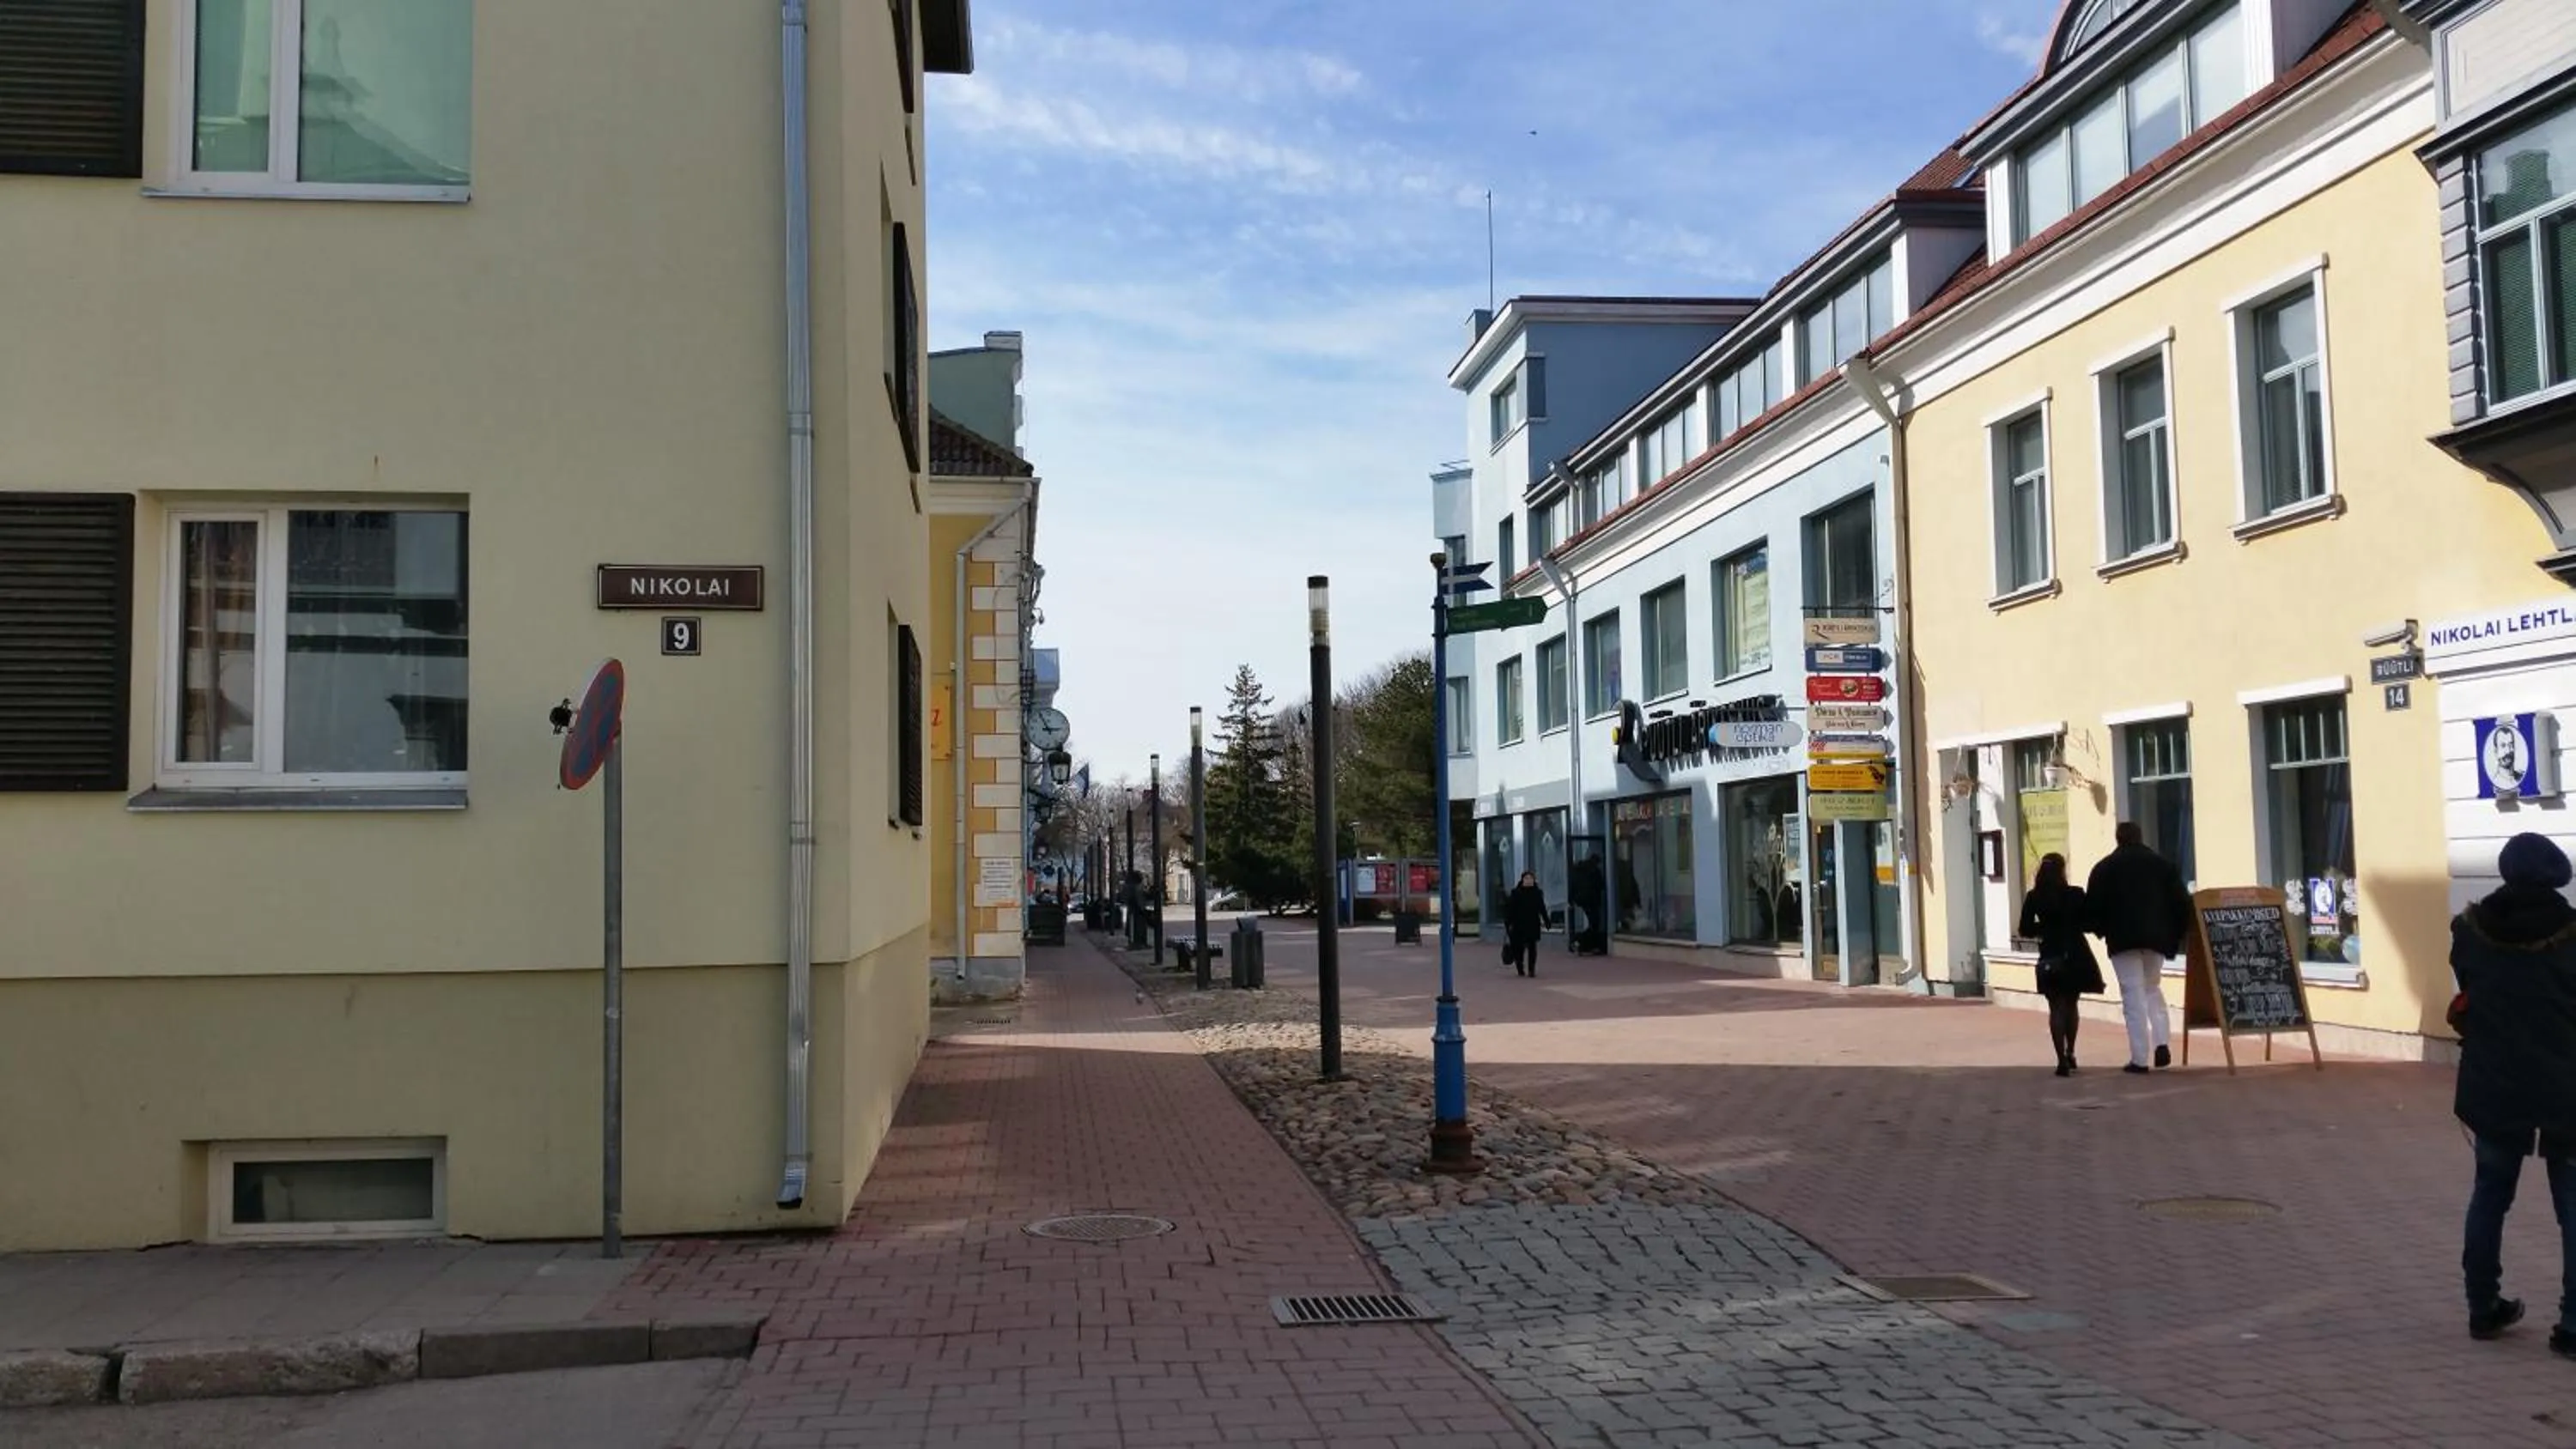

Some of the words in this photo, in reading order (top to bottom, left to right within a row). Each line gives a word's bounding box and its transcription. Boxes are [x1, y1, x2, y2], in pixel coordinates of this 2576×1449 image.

[630, 577, 730, 596] NIKOLAI
[673, 623, 690, 650] 9
[2431, 620, 2500, 646] NIKOLAI
[2508, 608, 2576, 633] LEHTL
[2390, 688, 2405, 706] 14
